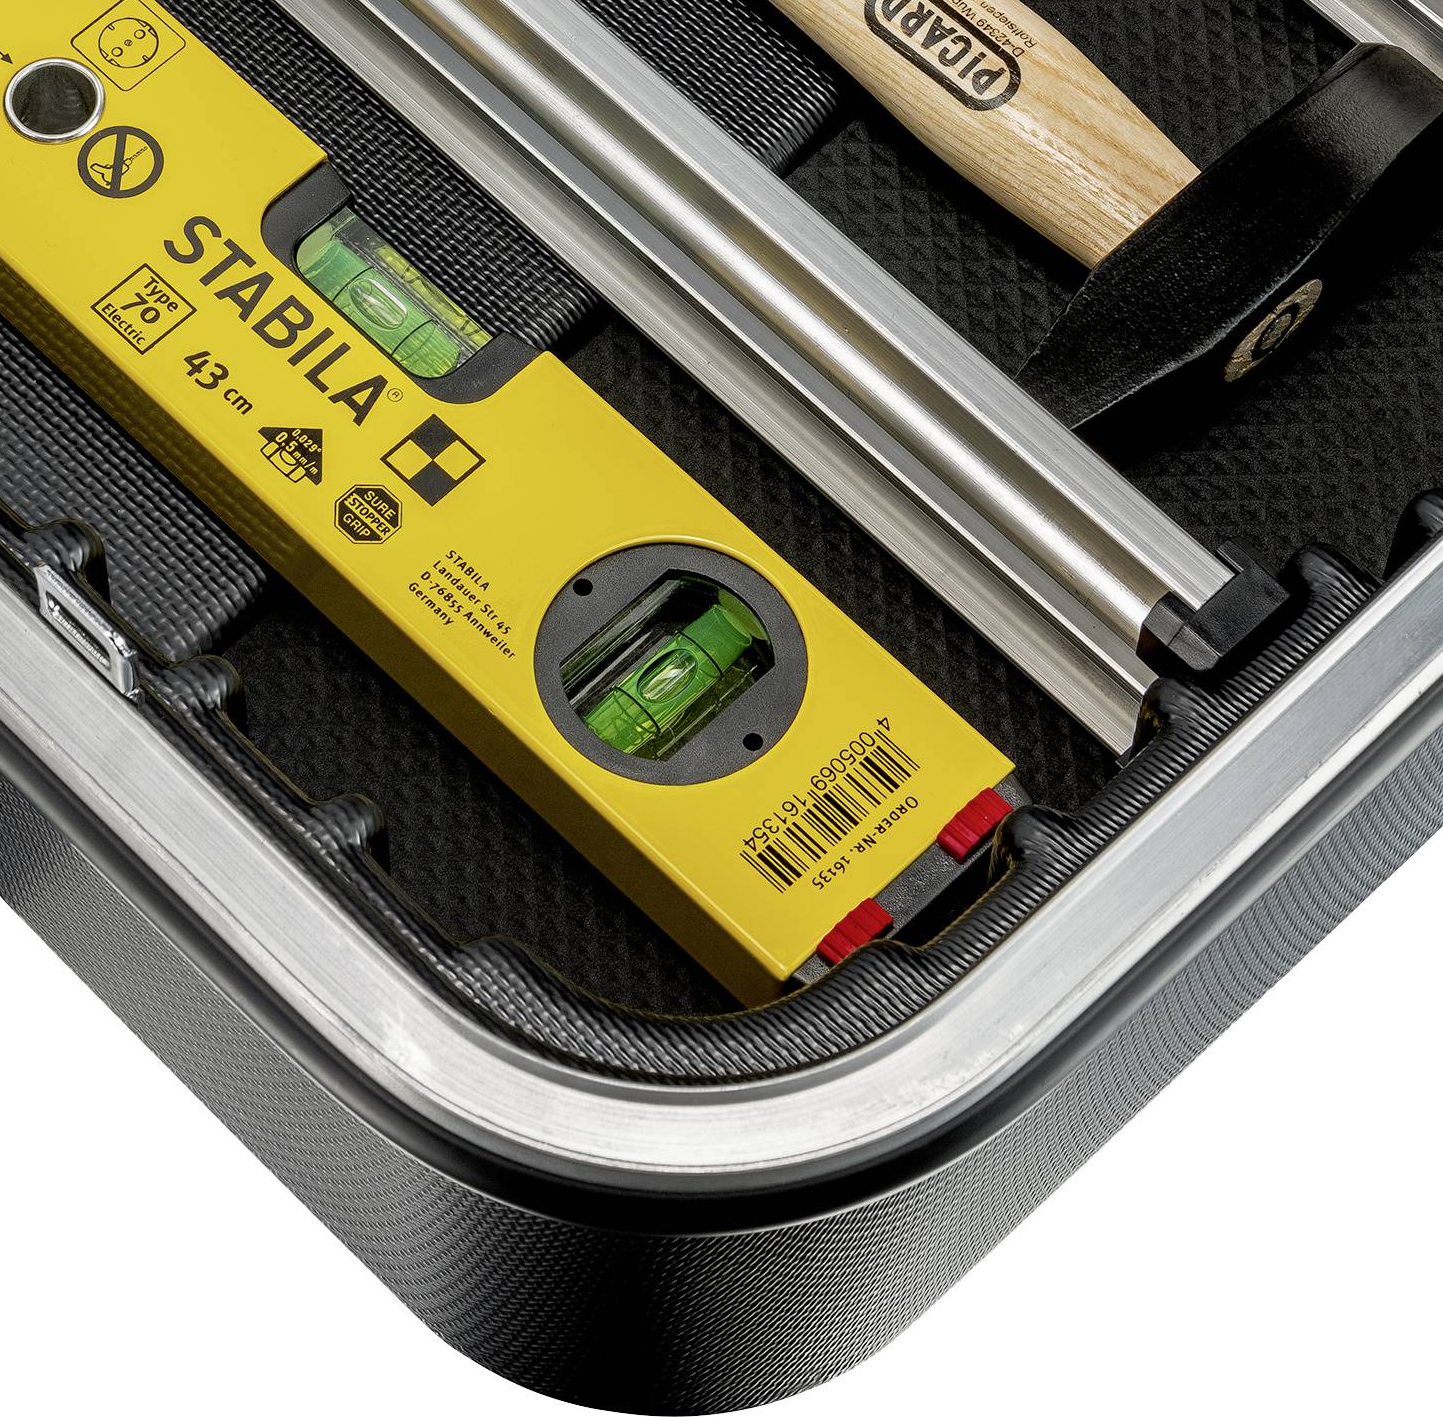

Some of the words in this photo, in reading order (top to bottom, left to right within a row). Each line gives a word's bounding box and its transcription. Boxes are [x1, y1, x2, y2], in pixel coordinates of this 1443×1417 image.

[120, 292, 161, 324] 70
[143, 275, 179, 313] Type
[100, 302, 146, 346] Electric
[183, 350, 230, 390] 43
[223, 387, 254, 416] cm
[342, 512, 372, 538] GRIP
[345, 495, 392, 537] STOPPER
[363, 490, 397, 521] SURE
[445, 549, 490, 592] STABILA
[408, 581, 455, 626] Germany
[420, 570, 465, 614] D-76855
[462, 611, 516, 659] Annweiler
[432, 560, 482, 605] Landauer
[479, 603, 499, 621] Str
[496, 621, 512, 635] 45
[811, 854, 851, 891] 16135
